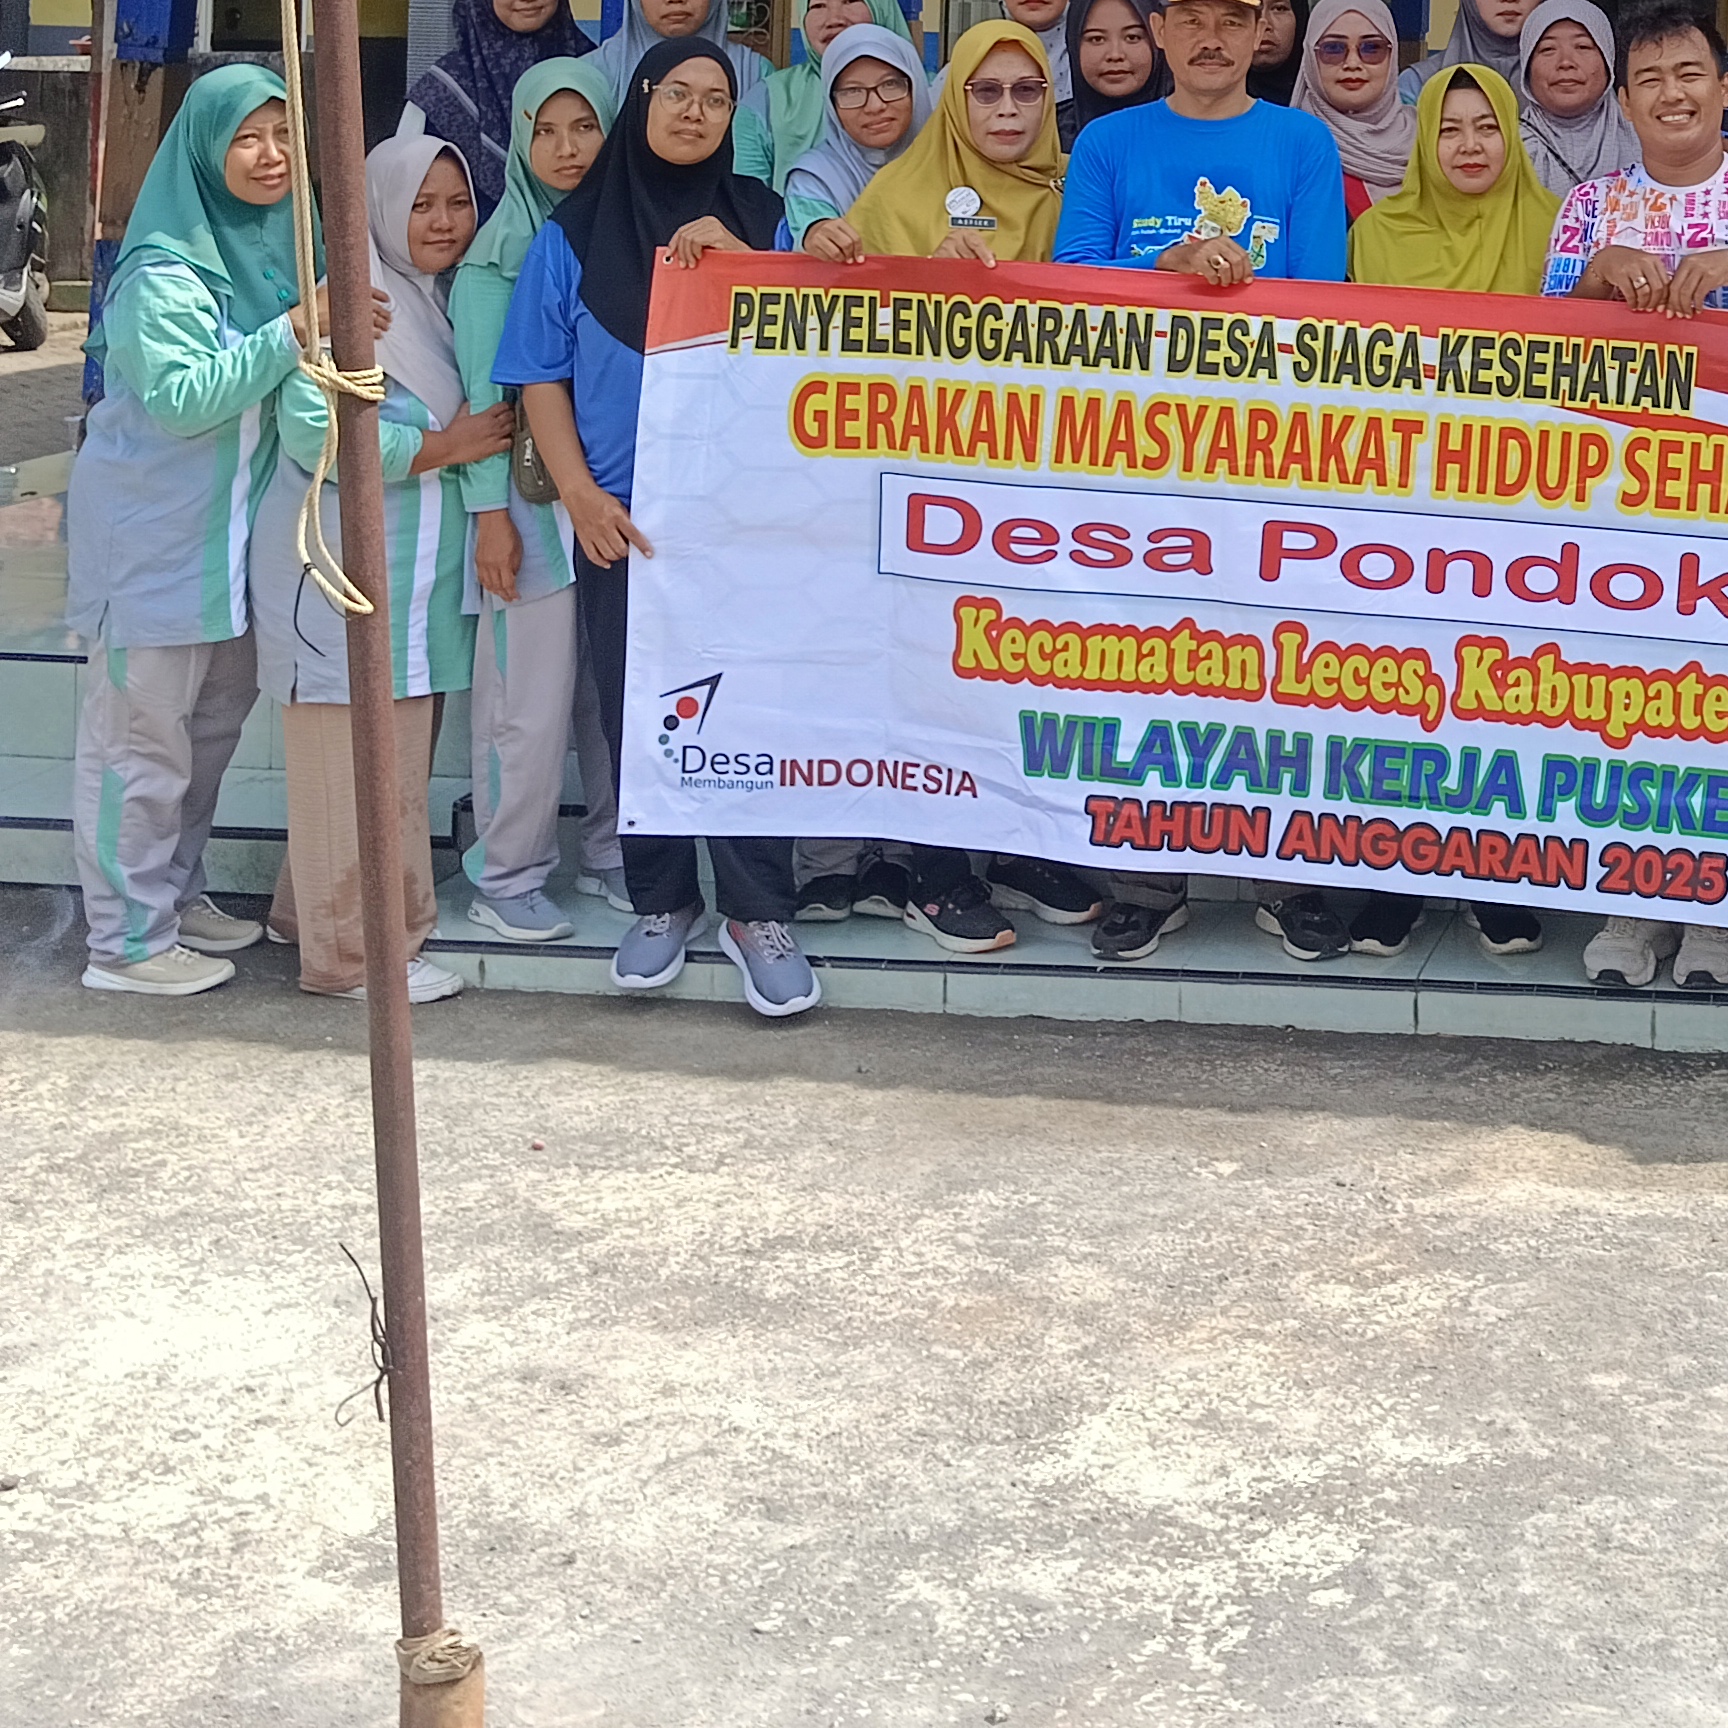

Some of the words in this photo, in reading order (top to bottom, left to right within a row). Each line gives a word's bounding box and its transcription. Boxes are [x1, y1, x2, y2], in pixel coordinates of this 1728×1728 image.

[1165, 216, 1192, 226] Tiru
[727, 290, 1157, 371] PENYELENGGARAAN
[1165, 314, 1279, 379] DESA
[1293, 320, 1425, 390] SIAGA
[1437, 332, 1696, 411] KESEHATAN
[792, 379, 1041, 465] GERAKAN
[1053, 393, 1425, 490] MASYARAKAT
[1434, 420, 1610, 505] HIDUP
[905, 491, 1214, 576] Desa
[954, 601, 1265, 695] Kecamatan
[1273, 626, 1442, 726] Leces,
[680, 775, 774, 793] Membangun
[681, 745, 774, 776] Desa
[779, 758, 979, 799] INDONESIA
[1020, 712, 1312, 797] WILAYAH
[1325, 736, 1526, 819] KERJA
[1087, 796, 1271, 857] TAHUN
[1277, 811, 1588, 890] ANGGARAN
[1598, 842, 1728, 904] 2025
